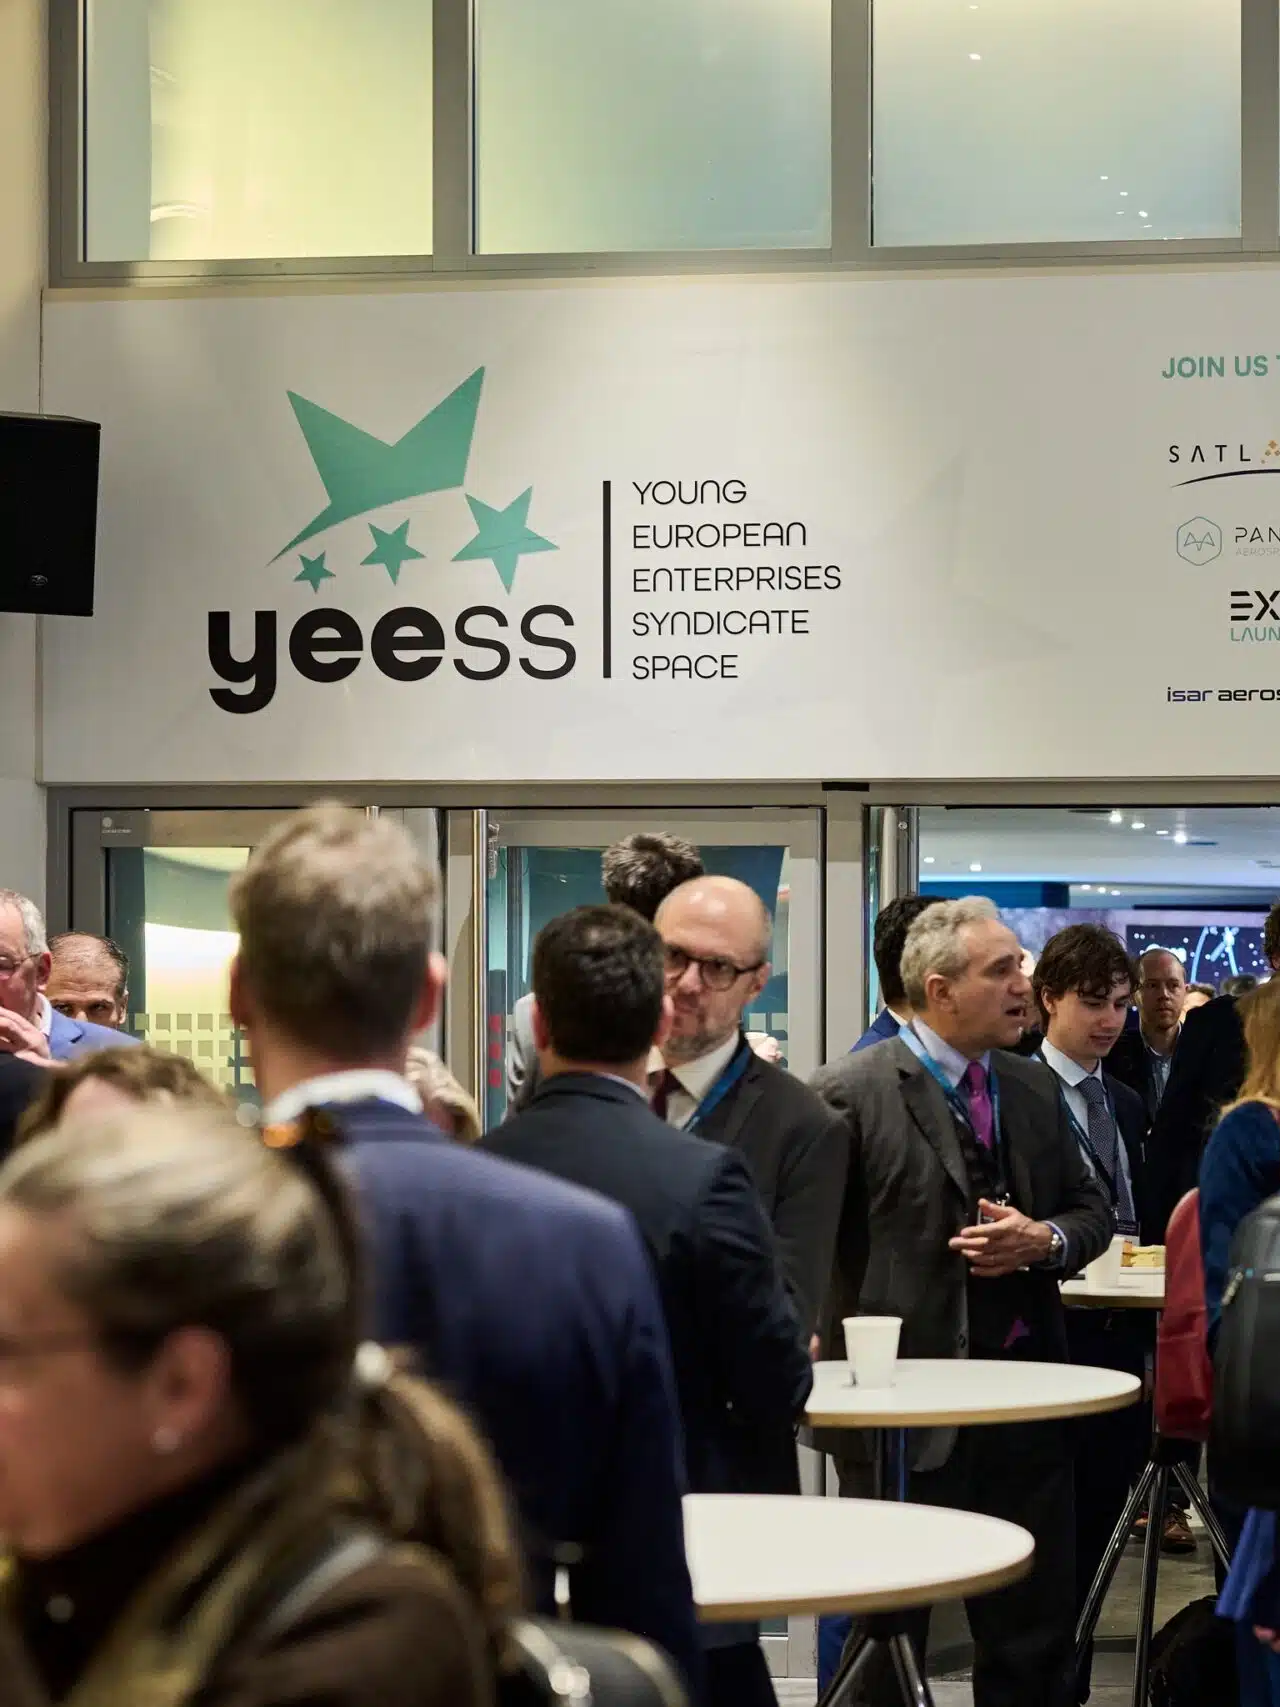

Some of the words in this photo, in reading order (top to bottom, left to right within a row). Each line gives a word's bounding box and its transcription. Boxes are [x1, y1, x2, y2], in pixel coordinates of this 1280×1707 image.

[1161, 356, 1226, 379] JOIN
[1234, 355, 1268, 377] US
[631, 479, 748, 505] YOUNG
[632, 521, 807, 549] EUROPEAN
[632, 564, 842, 593] ENTERPRISES
[631, 608, 810, 637] SYNDICATE
[207, 603, 577, 714] yeess
[631, 654, 739, 681] SPACE
[1166, 686, 1214, 703] isar
